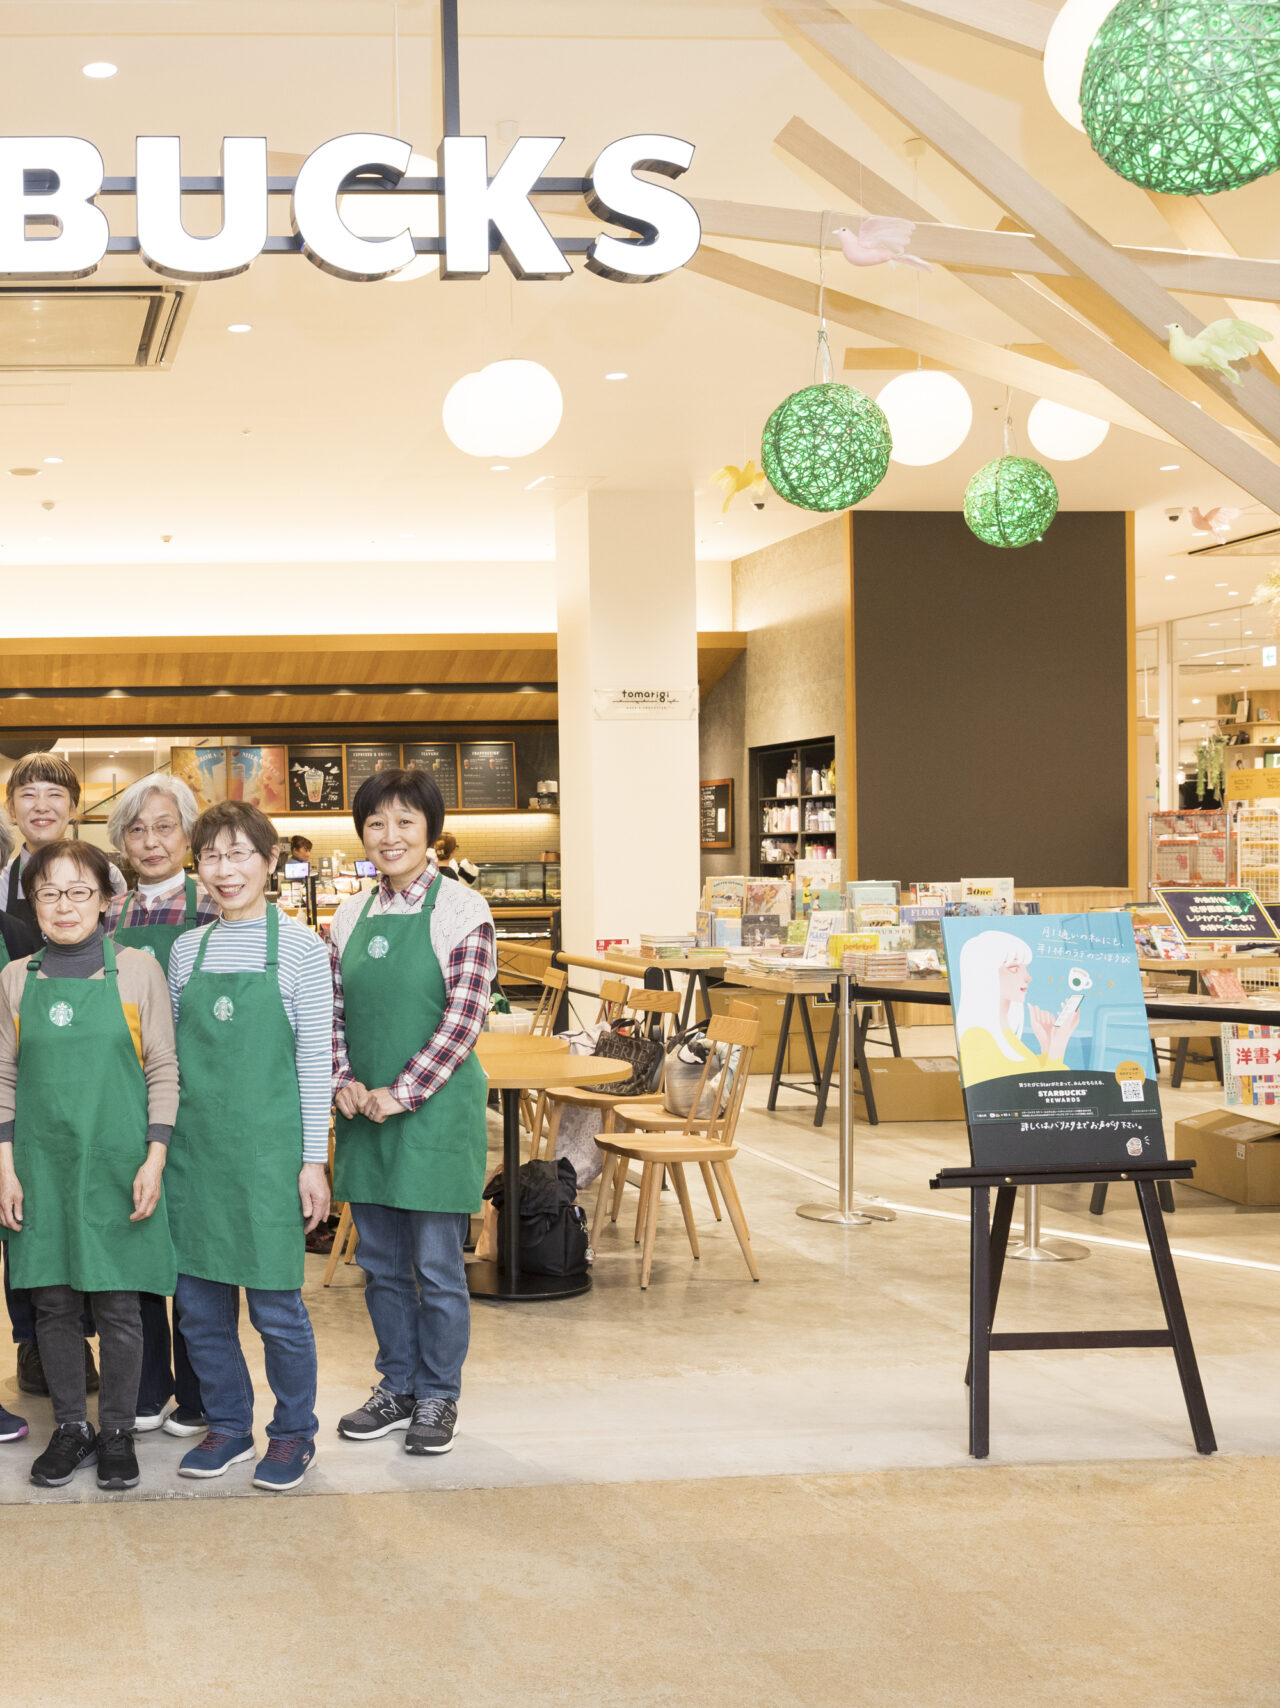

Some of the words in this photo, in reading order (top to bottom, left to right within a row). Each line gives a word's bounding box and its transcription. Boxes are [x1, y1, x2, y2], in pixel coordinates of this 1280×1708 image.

[621, 689, 670, 703] tomarigi
[1236, 1047, 1270, 1066] 洋書
[1037, 1089, 1087, 1097] STARBUCKS
